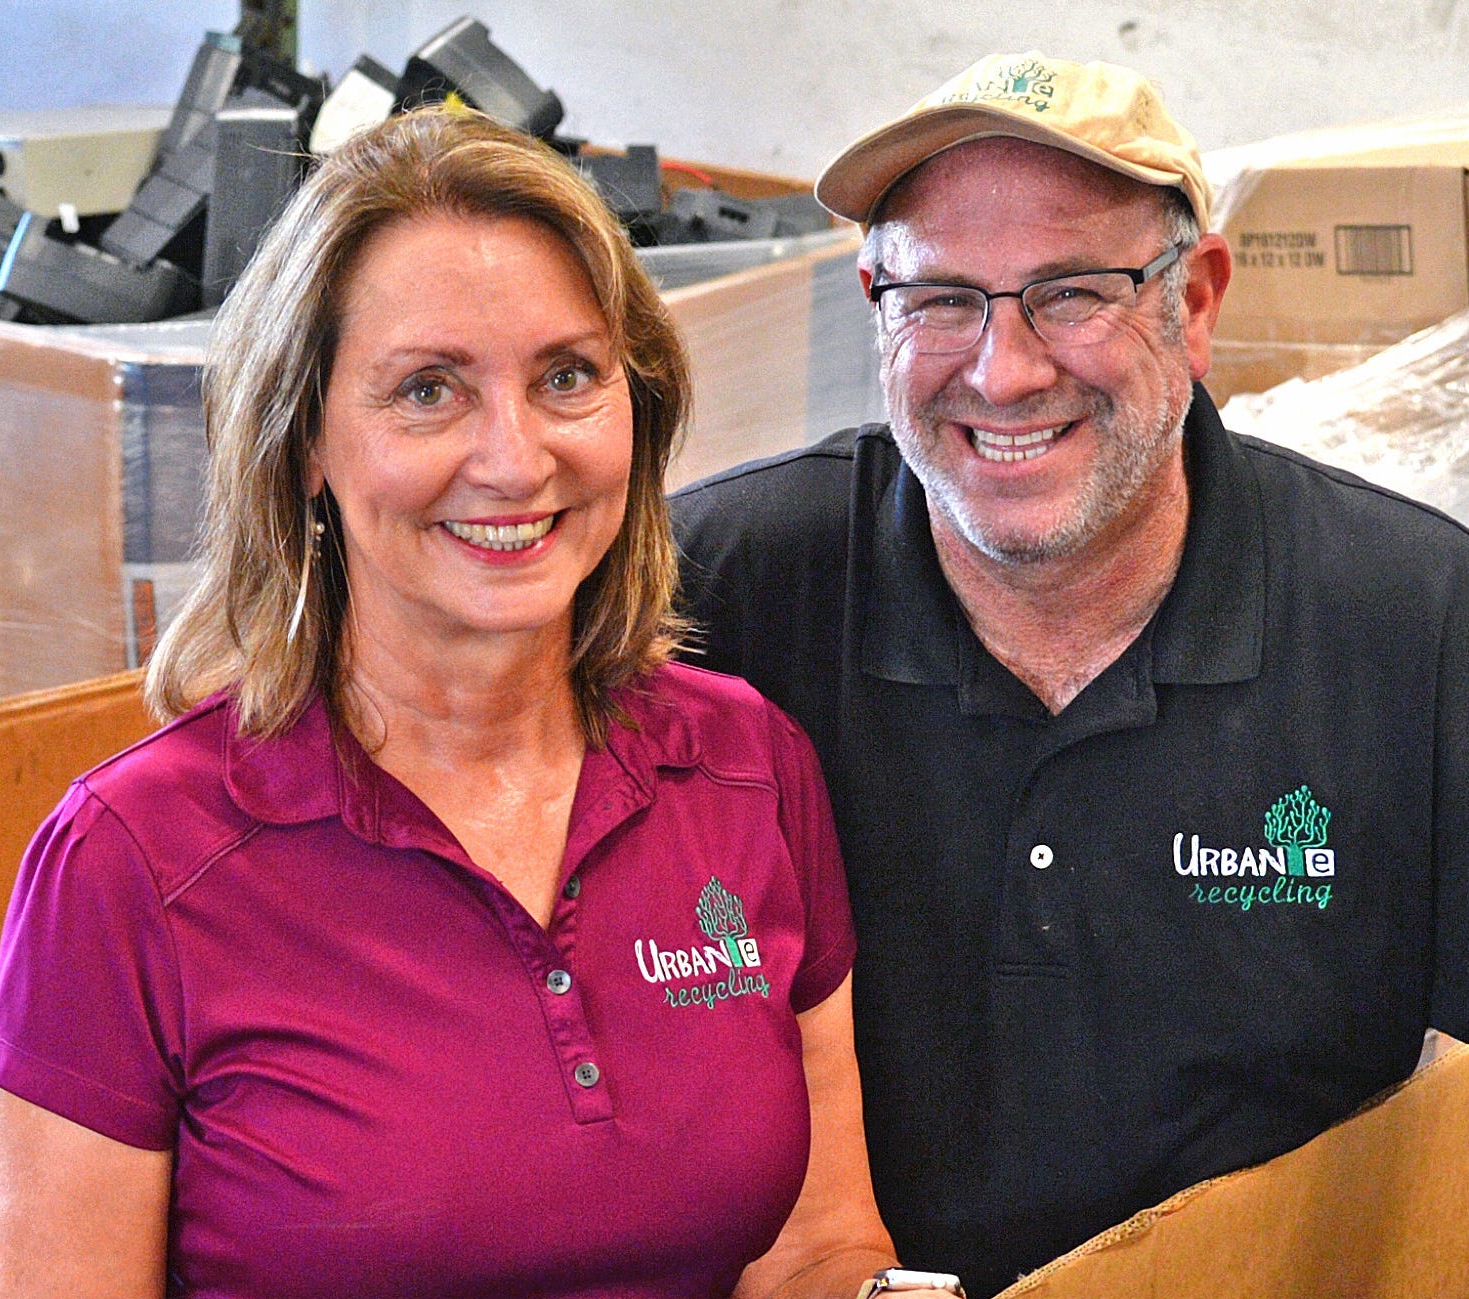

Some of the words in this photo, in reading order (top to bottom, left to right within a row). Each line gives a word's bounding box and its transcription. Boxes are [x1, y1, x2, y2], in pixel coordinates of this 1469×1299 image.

[1173, 832, 1287, 877] URBAN
[1188, 876, 1333, 911] recycling
[634, 938, 733, 984] URBAN
[663, 967, 771, 1010] recycling
